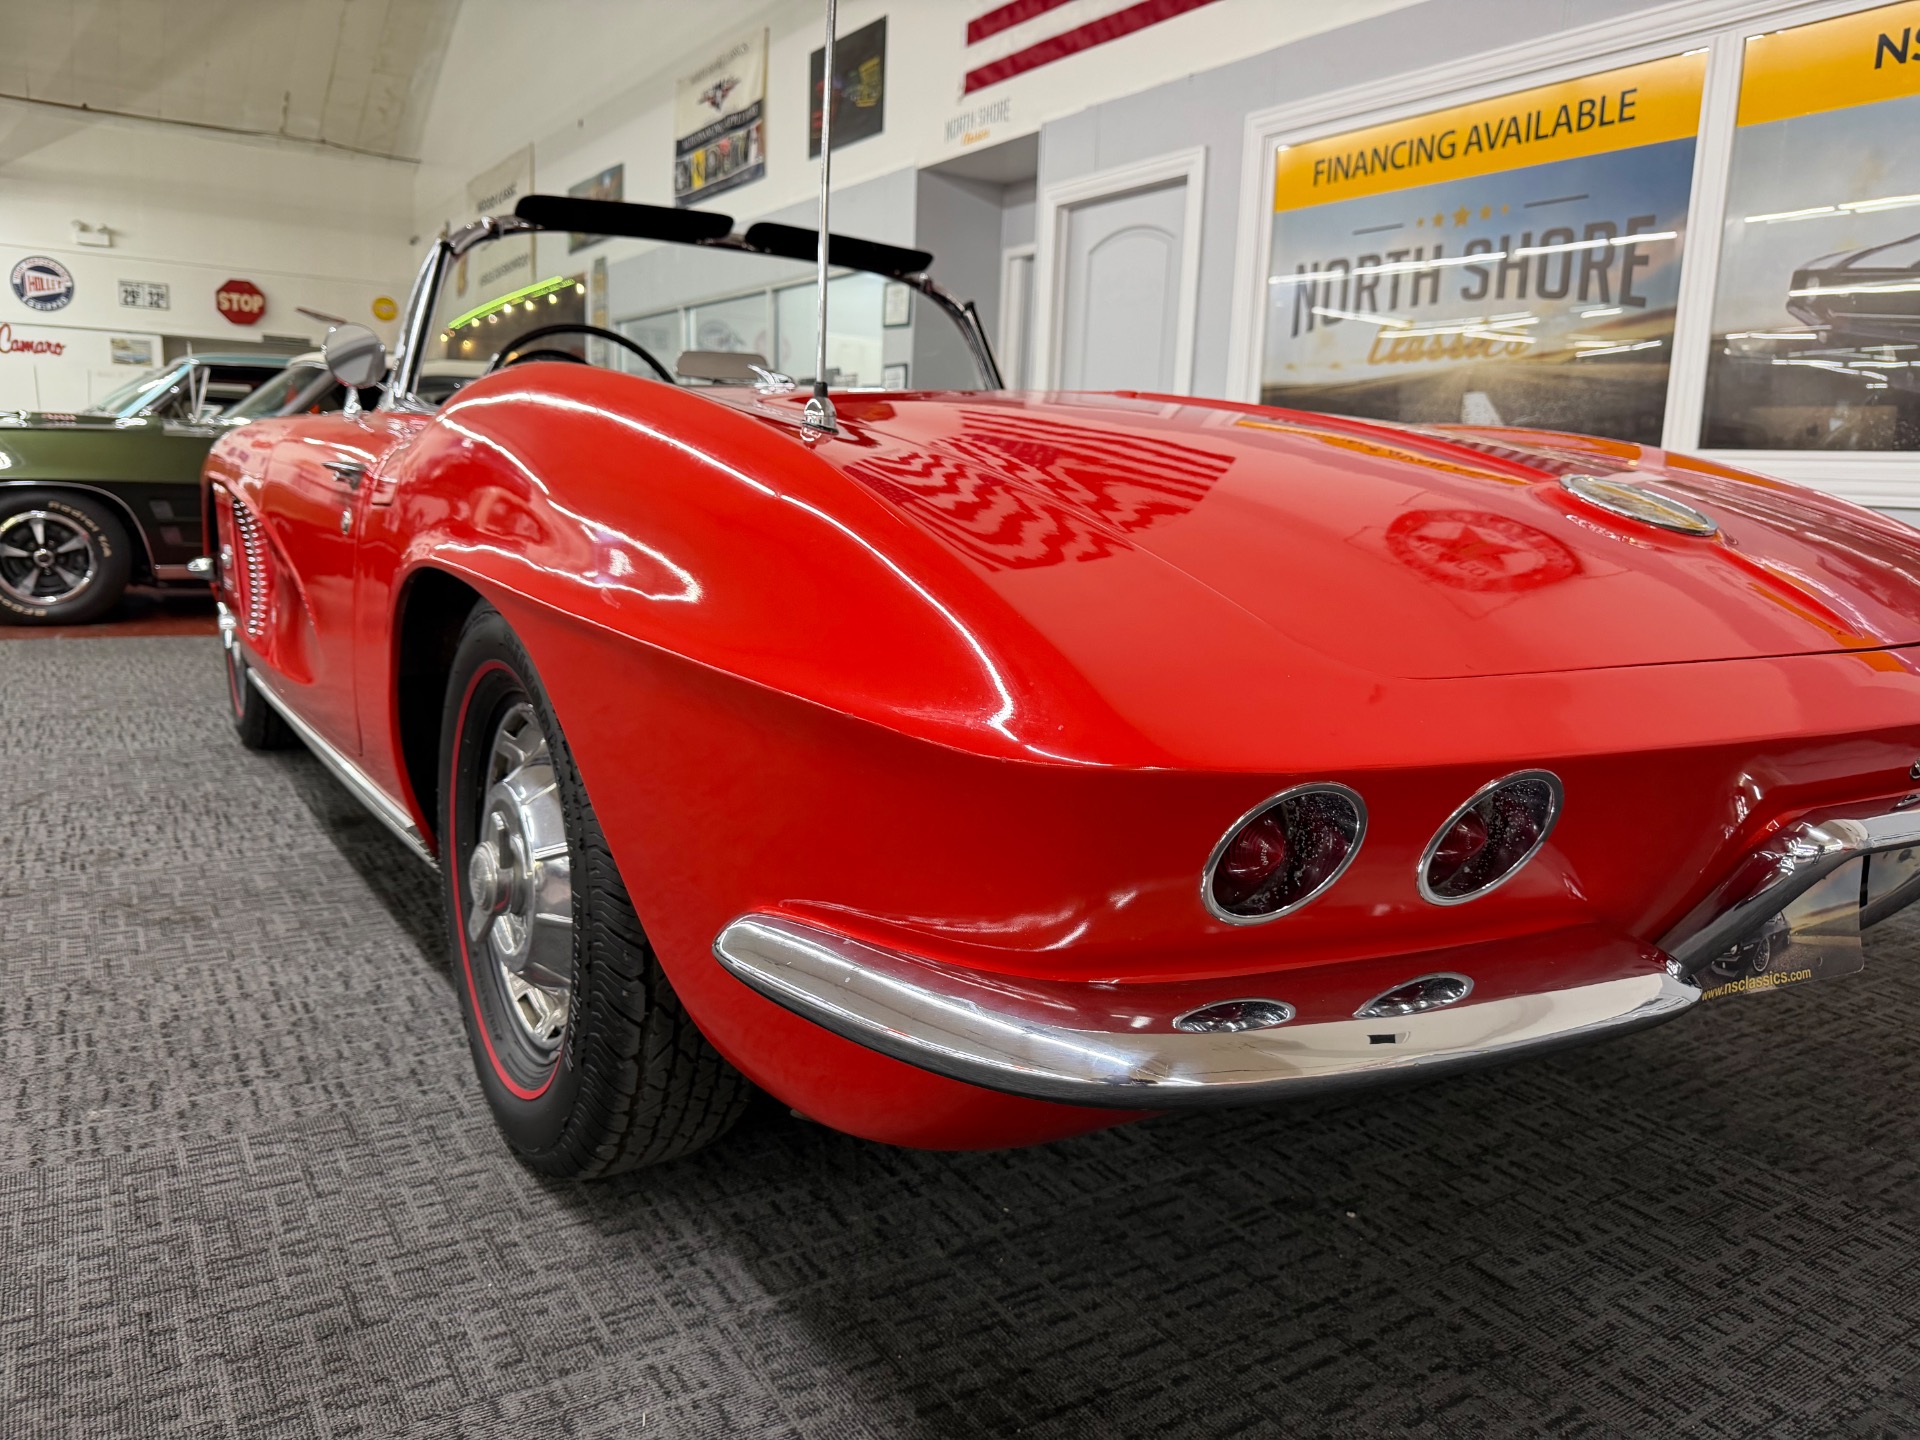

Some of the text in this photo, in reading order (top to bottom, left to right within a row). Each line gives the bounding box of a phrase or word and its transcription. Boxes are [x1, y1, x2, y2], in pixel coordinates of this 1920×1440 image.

[1312, 88, 1638, 187] FINANCING AVAILABLE
[1290, 215, 1657, 338] NORTH SHORE
[217, 291, 264, 314] STOP
[0, 322, 66, 356] Camaro
[1701, 968, 1812, 1002] www.nsclassics.com
